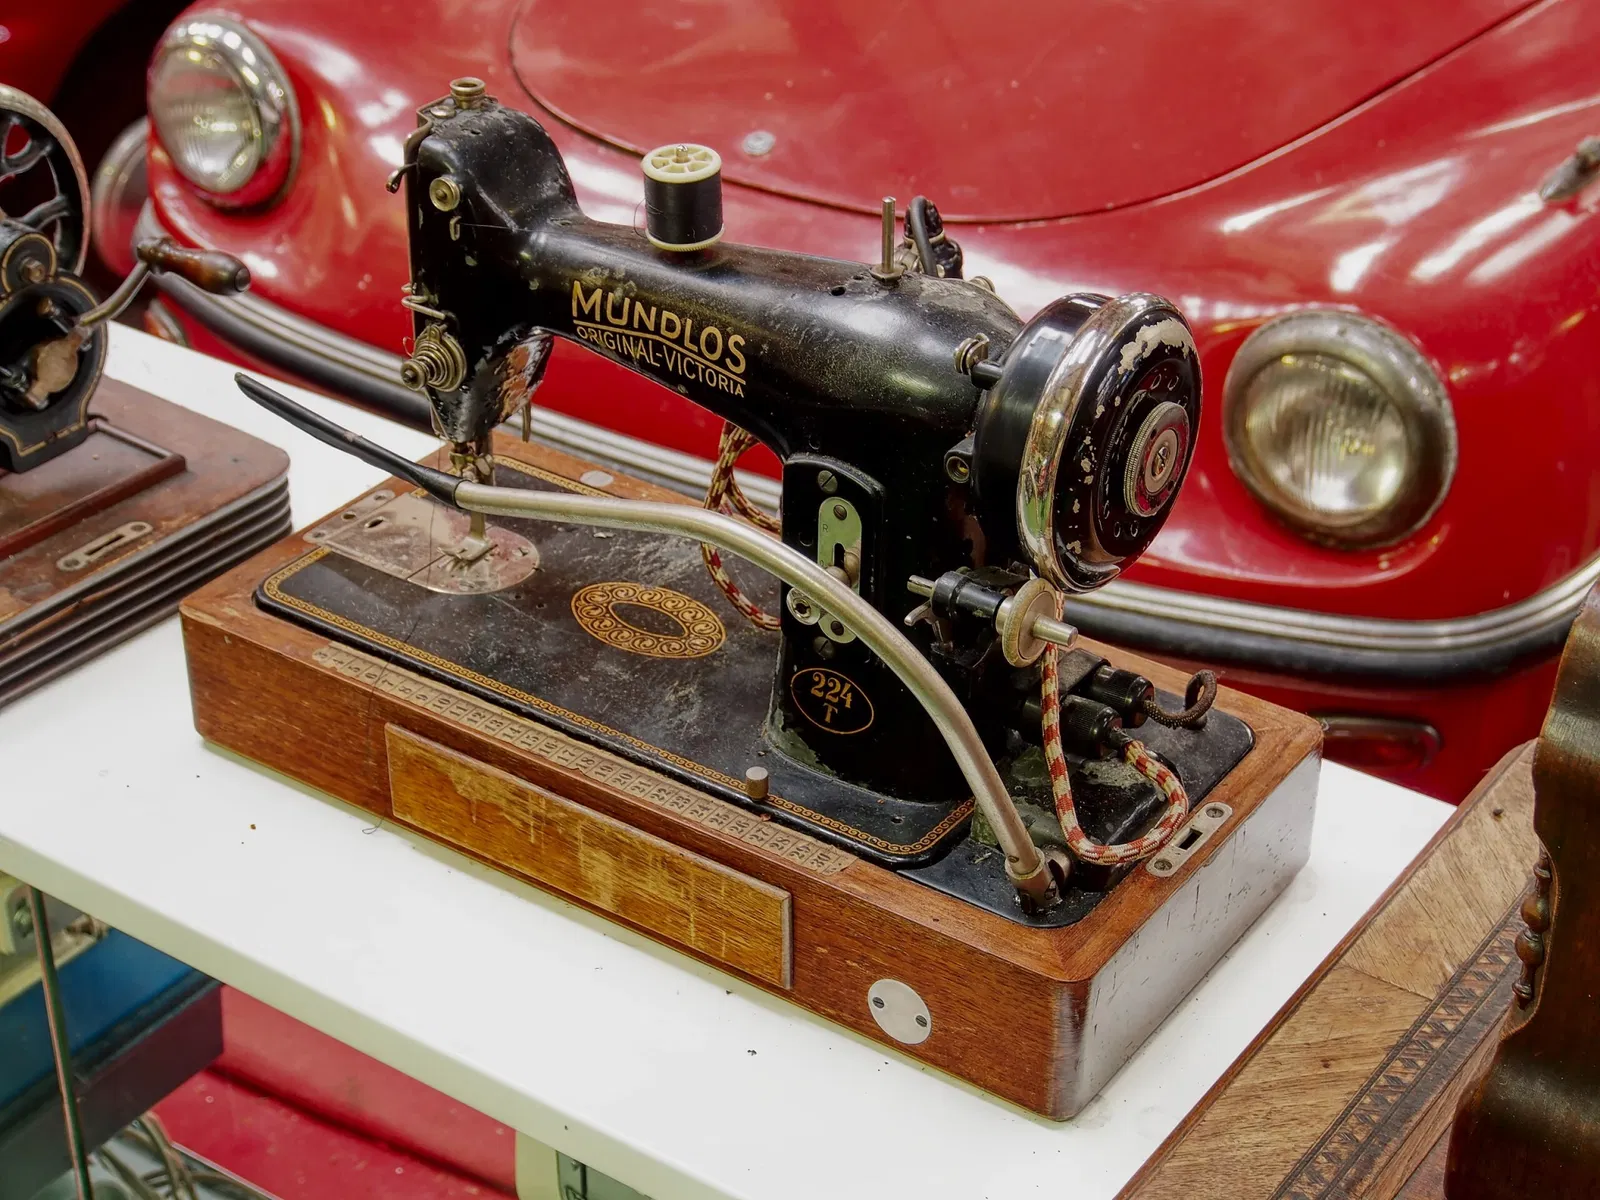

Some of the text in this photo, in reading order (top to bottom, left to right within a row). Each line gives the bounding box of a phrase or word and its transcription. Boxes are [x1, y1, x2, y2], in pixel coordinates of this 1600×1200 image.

[572, 280, 746, 375] MUNDLOS
[576, 326, 745, 398] ORIGINAL-VICTORIA
[822, 523, 829, 533] R
[810, 671, 852, 709] 224
[823, 703, 838, 723] T
[347, 665, 360, 673] 5
[398, 686, 412, 694] 8
[415, 693, 428, 701] 9
[432, 698, 450, 709] 10
[449, 705, 468, 716] 11
[467, 712, 486, 724] 12
[484, 719, 503, 732] 13
[502, 727, 521, 739] 14
[521, 735, 539, 746] 15
[539, 742, 558, 754] 16
[557, 749, 576, 762] 17
[575, 757, 595, 769] 18
[594, 765, 613, 777] 19
[612, 773, 633, 785] 20
[630, 781, 651, 793] 21
[650, 788, 672, 801] 22
[669, 795, 691, 809] 23
[689, 804, 712, 818] 24
[708, 813, 730, 826] 25
[729, 820, 750, 834] 26
[748, 828, 769, 842] 27
[769, 837, 791, 851] 28
[789, 845, 811, 859] 29
[810, 853, 831, 867] 30
